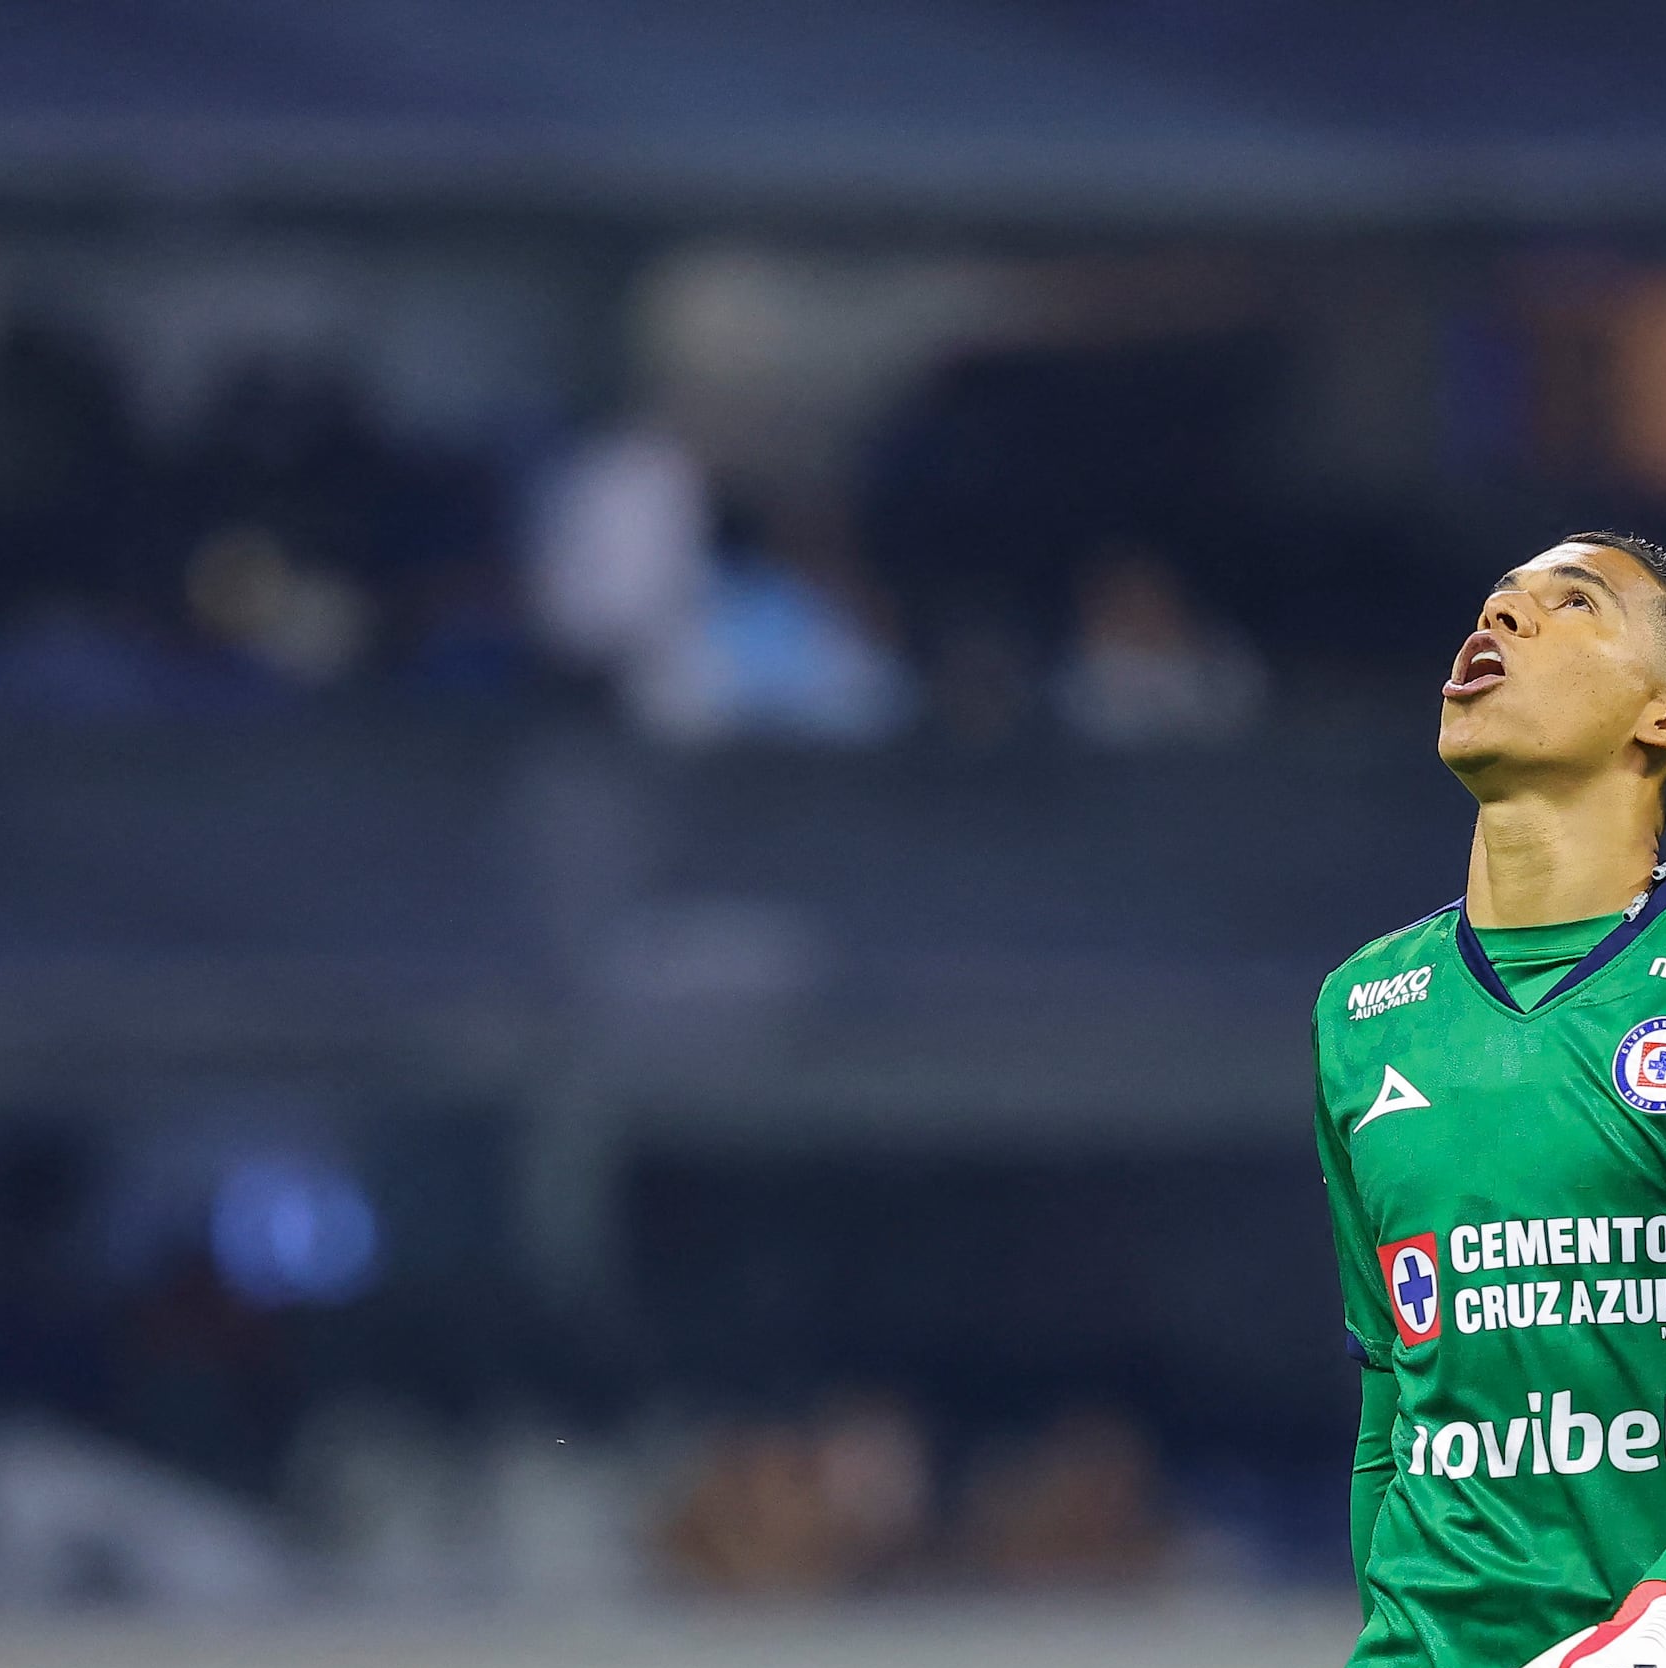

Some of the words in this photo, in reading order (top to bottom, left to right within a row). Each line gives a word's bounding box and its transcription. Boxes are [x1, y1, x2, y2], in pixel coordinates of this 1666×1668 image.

[1347, 964, 1433, 1011] NIKKO
[1621, 1026, 1646, 1055] CLUB
[1624, 1090, 1653, 1110] CRUZ
[1453, 1280, 1563, 1335] CRUZ
